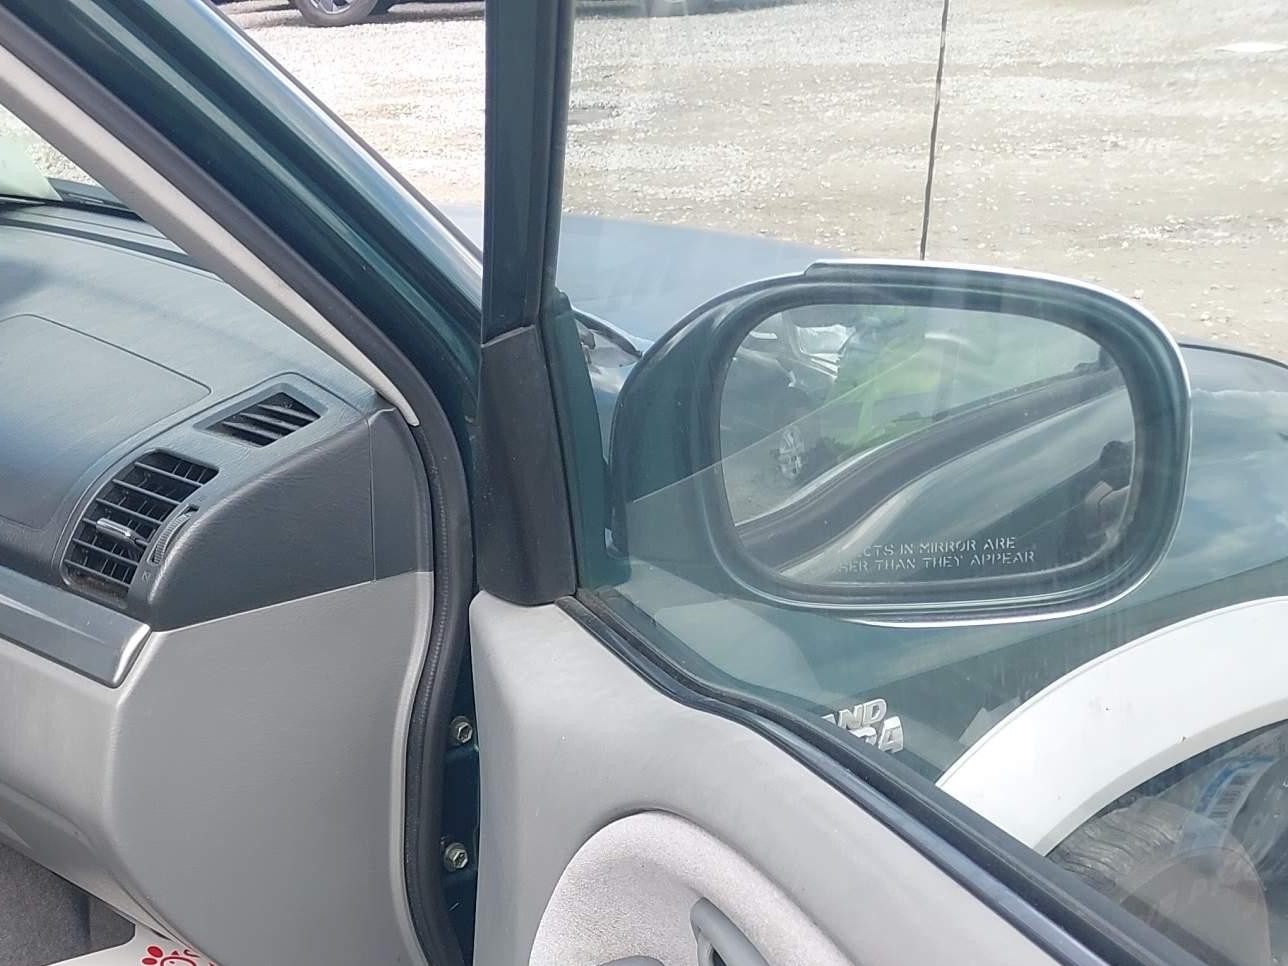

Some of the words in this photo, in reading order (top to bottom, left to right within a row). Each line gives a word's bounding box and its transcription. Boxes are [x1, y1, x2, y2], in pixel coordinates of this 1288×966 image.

[857, 543, 895, 558] CTS
[899, 543, 914, 555] IN
[919, 538, 977, 554] MIRROR
[983, 536, 1017, 550] ARE
[875, 557, 916, 571] THAN
[922, 554, 964, 569] THEY
[970, 551, 1035, 567] APPEAR
